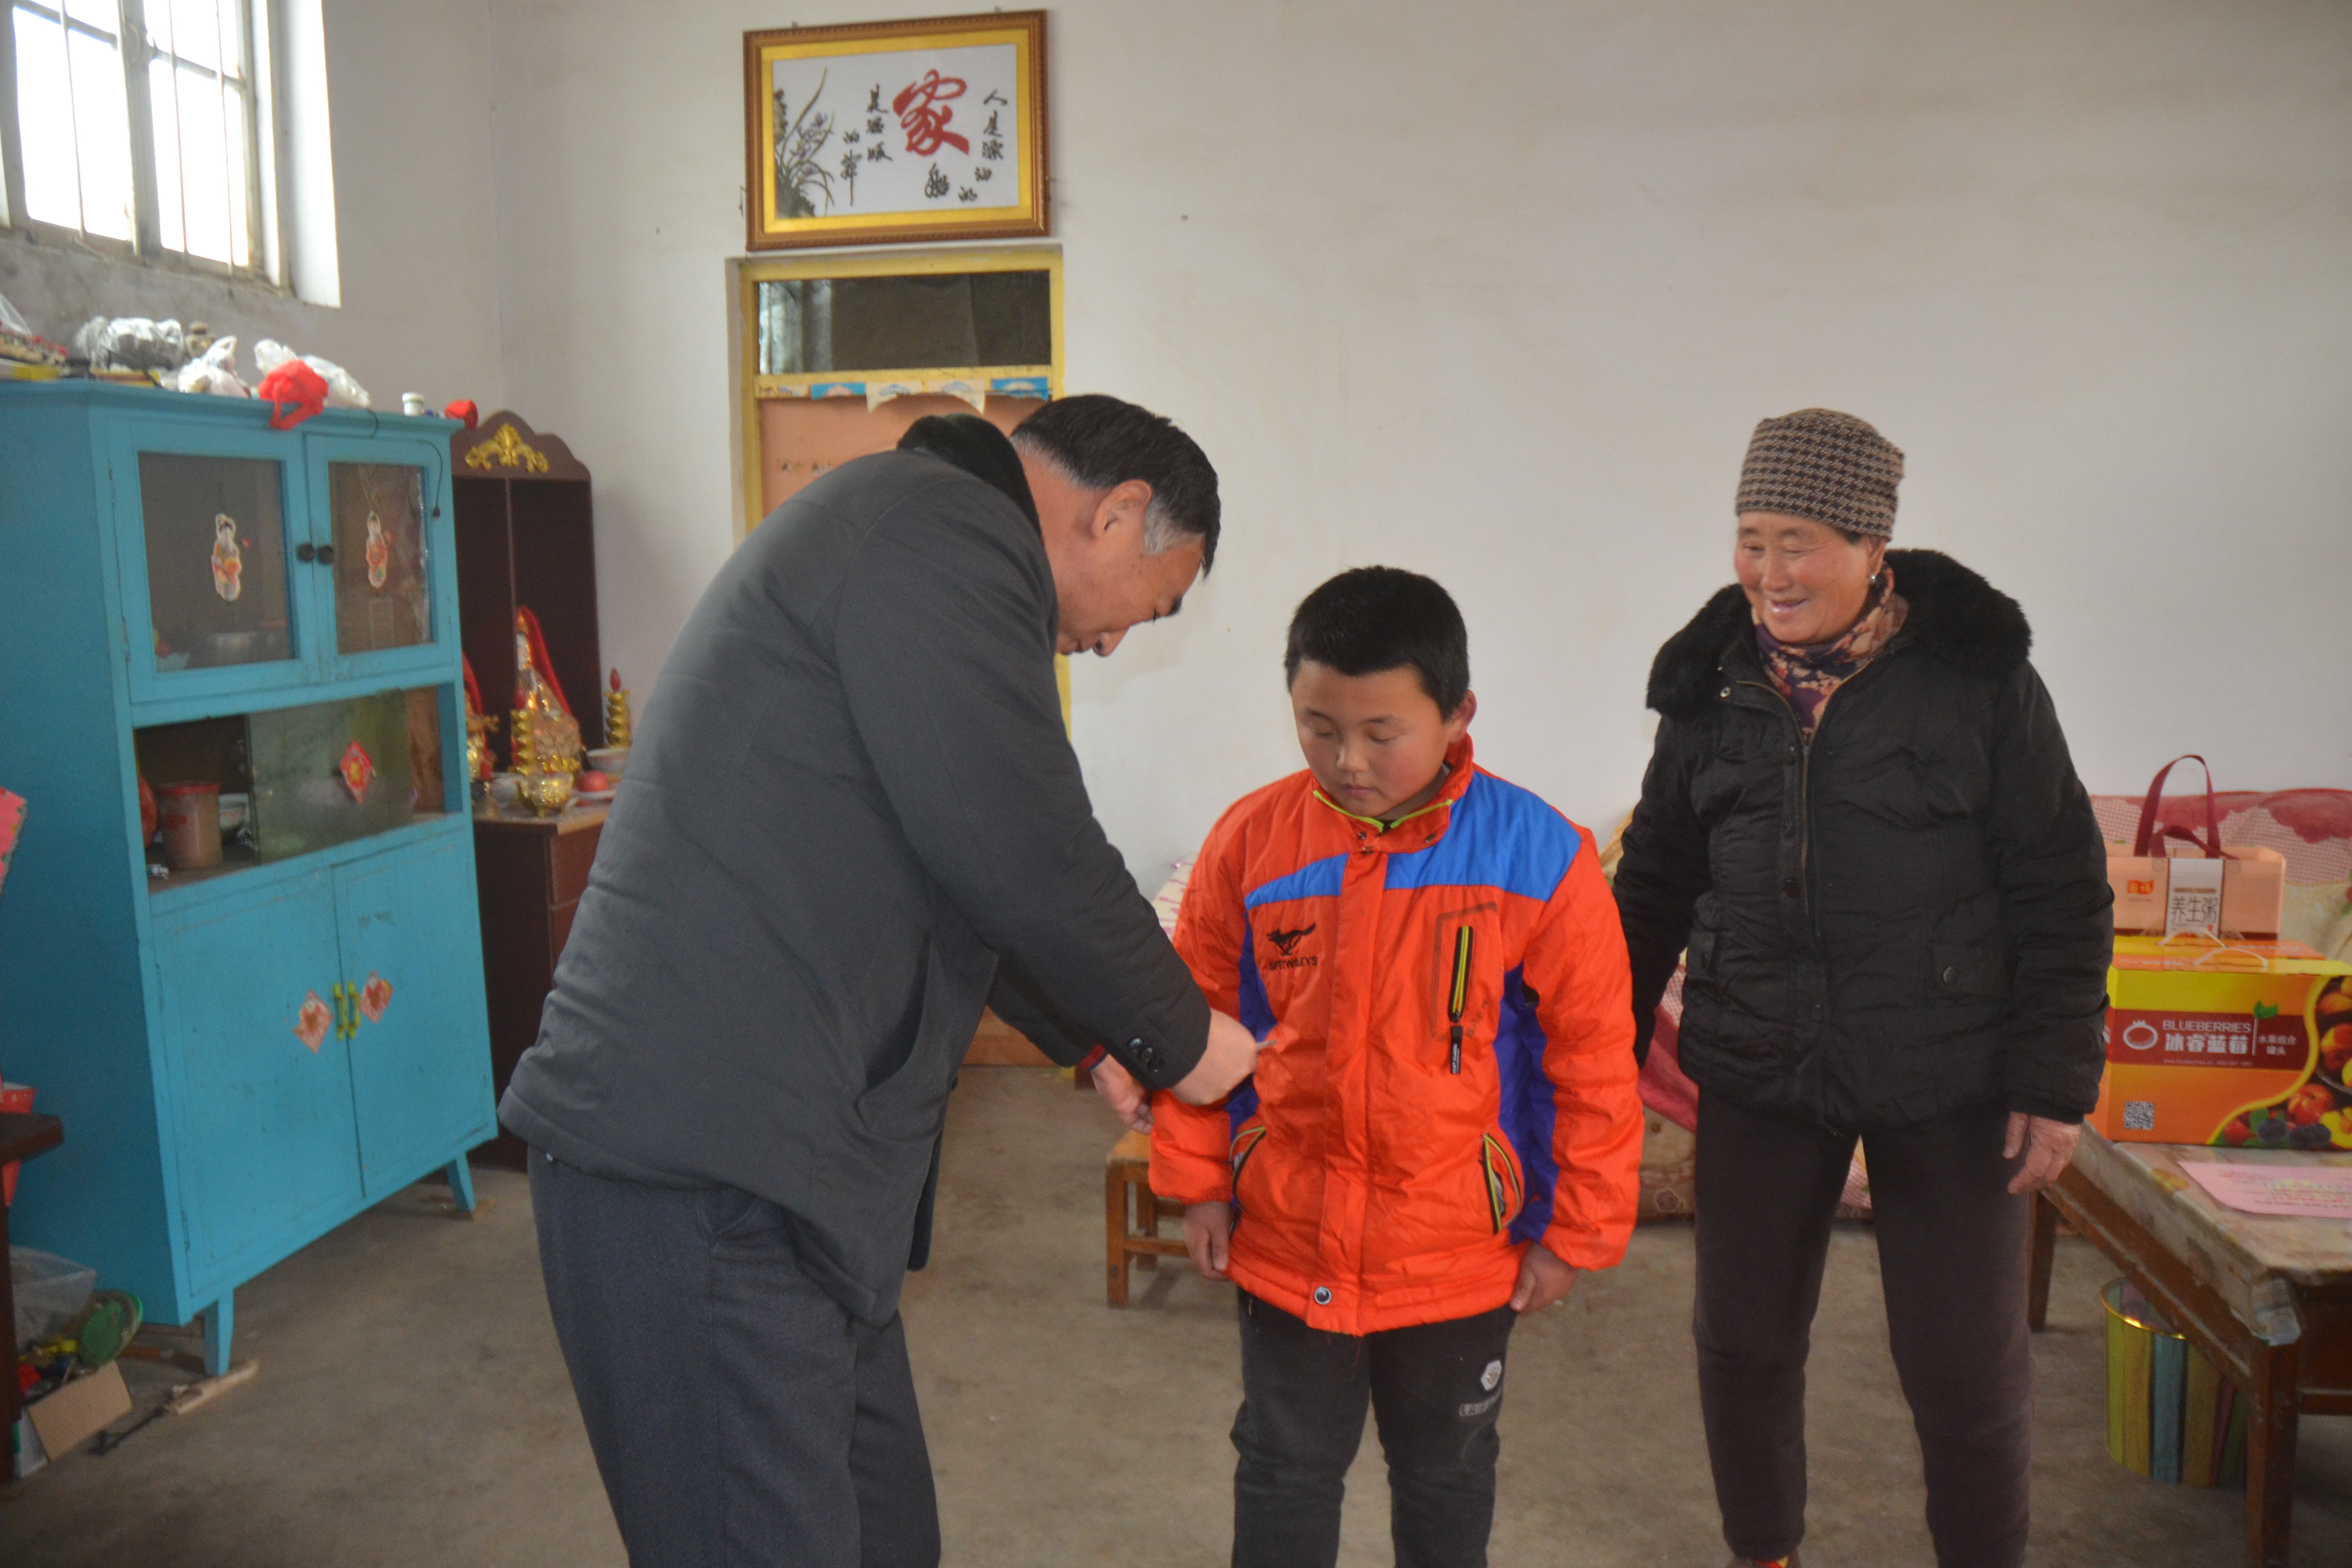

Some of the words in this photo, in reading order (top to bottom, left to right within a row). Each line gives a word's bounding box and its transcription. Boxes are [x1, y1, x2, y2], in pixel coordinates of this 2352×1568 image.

[892, 68, 970, 157] 家
[2171, 895, 2218, 923] 养生粥
[2162, 1019, 2252, 1034] BLUEBERRIES
[2257, 1034, 2297, 1045] 水果组合
[2266, 1045, 2286, 1055] 罐头
